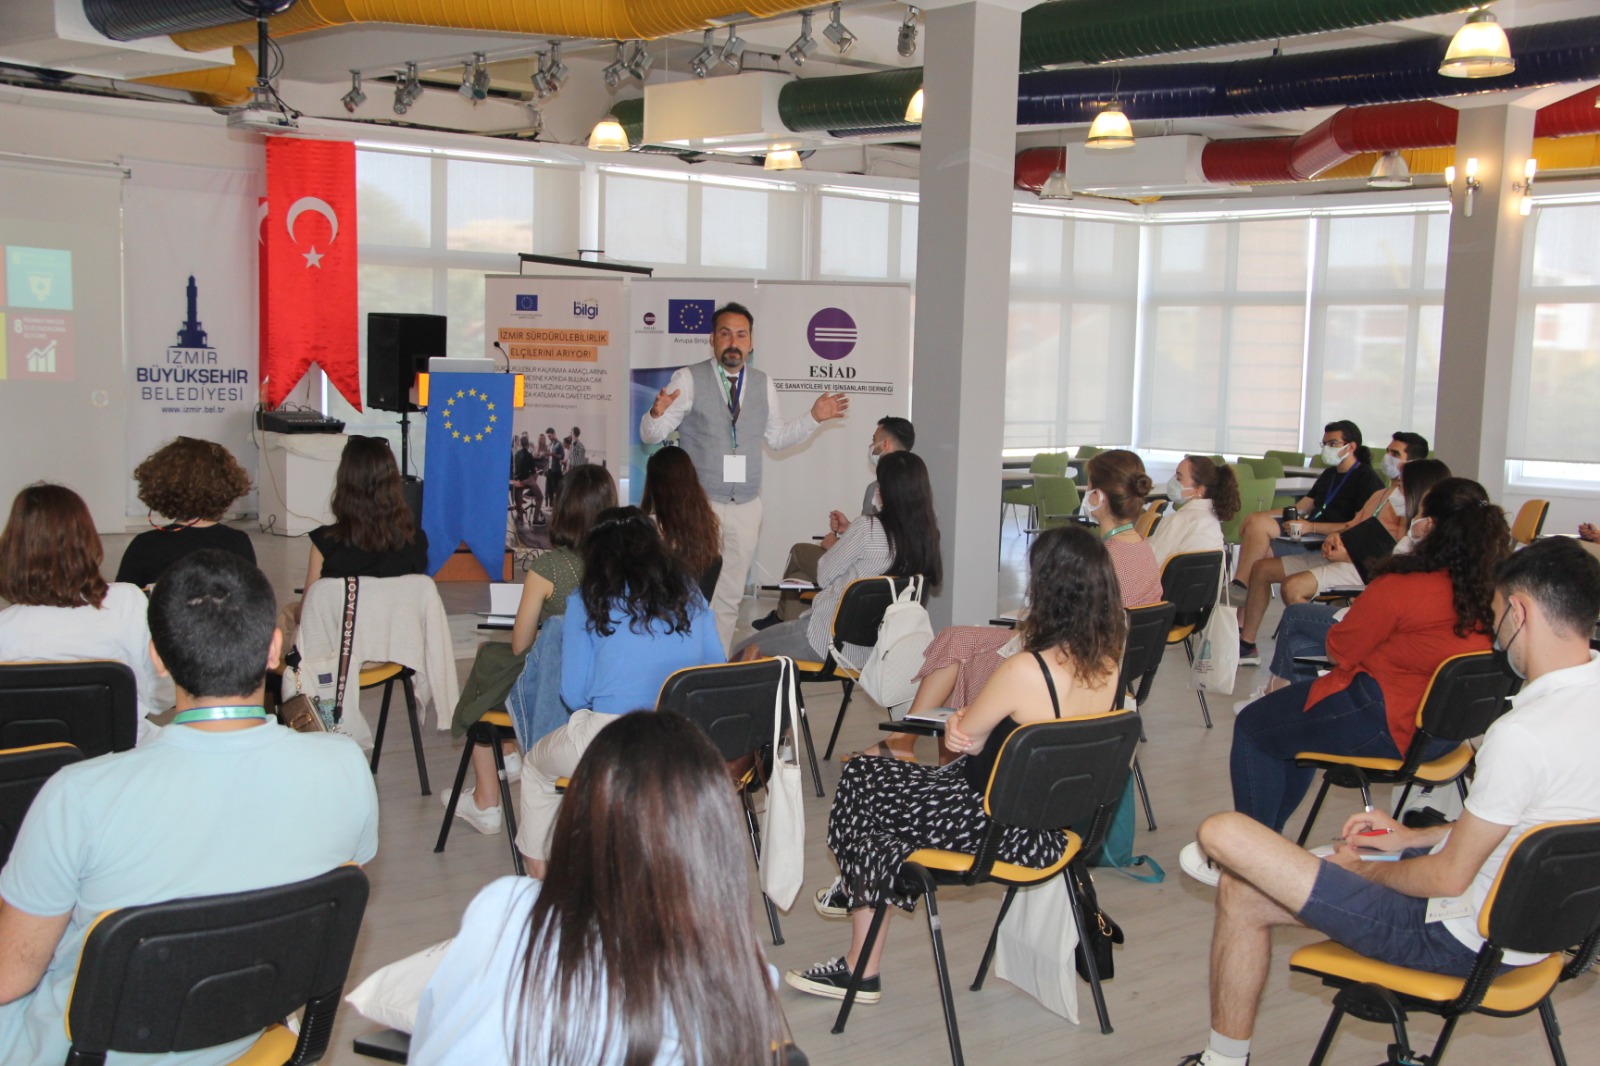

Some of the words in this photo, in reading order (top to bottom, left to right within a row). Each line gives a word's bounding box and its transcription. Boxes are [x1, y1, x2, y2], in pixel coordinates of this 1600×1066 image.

[573, 301, 599, 320] bilgi
[15, 319, 22, 334] 8
[500, 331, 524, 340] İZMİR
[526, 331, 607, 342] SÜRDÜRÜLEBİLİRLİK
[674, 337, 693, 345] Avrupa
[694, 337, 709, 345] Birliğ
[166, 349, 218, 364] İZMİR
[510, 348, 554, 358] ELÇİLERİNİ
[556, 349, 591, 358] ARIYOR!
[136, 364, 249, 386] BÜYÜKŞEHİR
[809, 363, 857, 379] ESİAD
[142, 386, 243, 401] BELEDİYESİ
[785, 382, 823, 390] SANAYİCİLERİ
[868, 385, 894, 393] DERNEĞİ
[162, 405, 225, 414] www.izmir.bel.tr
[346, 576, 357, 616] JACOB
[342, 620, 353, 656] MARC
